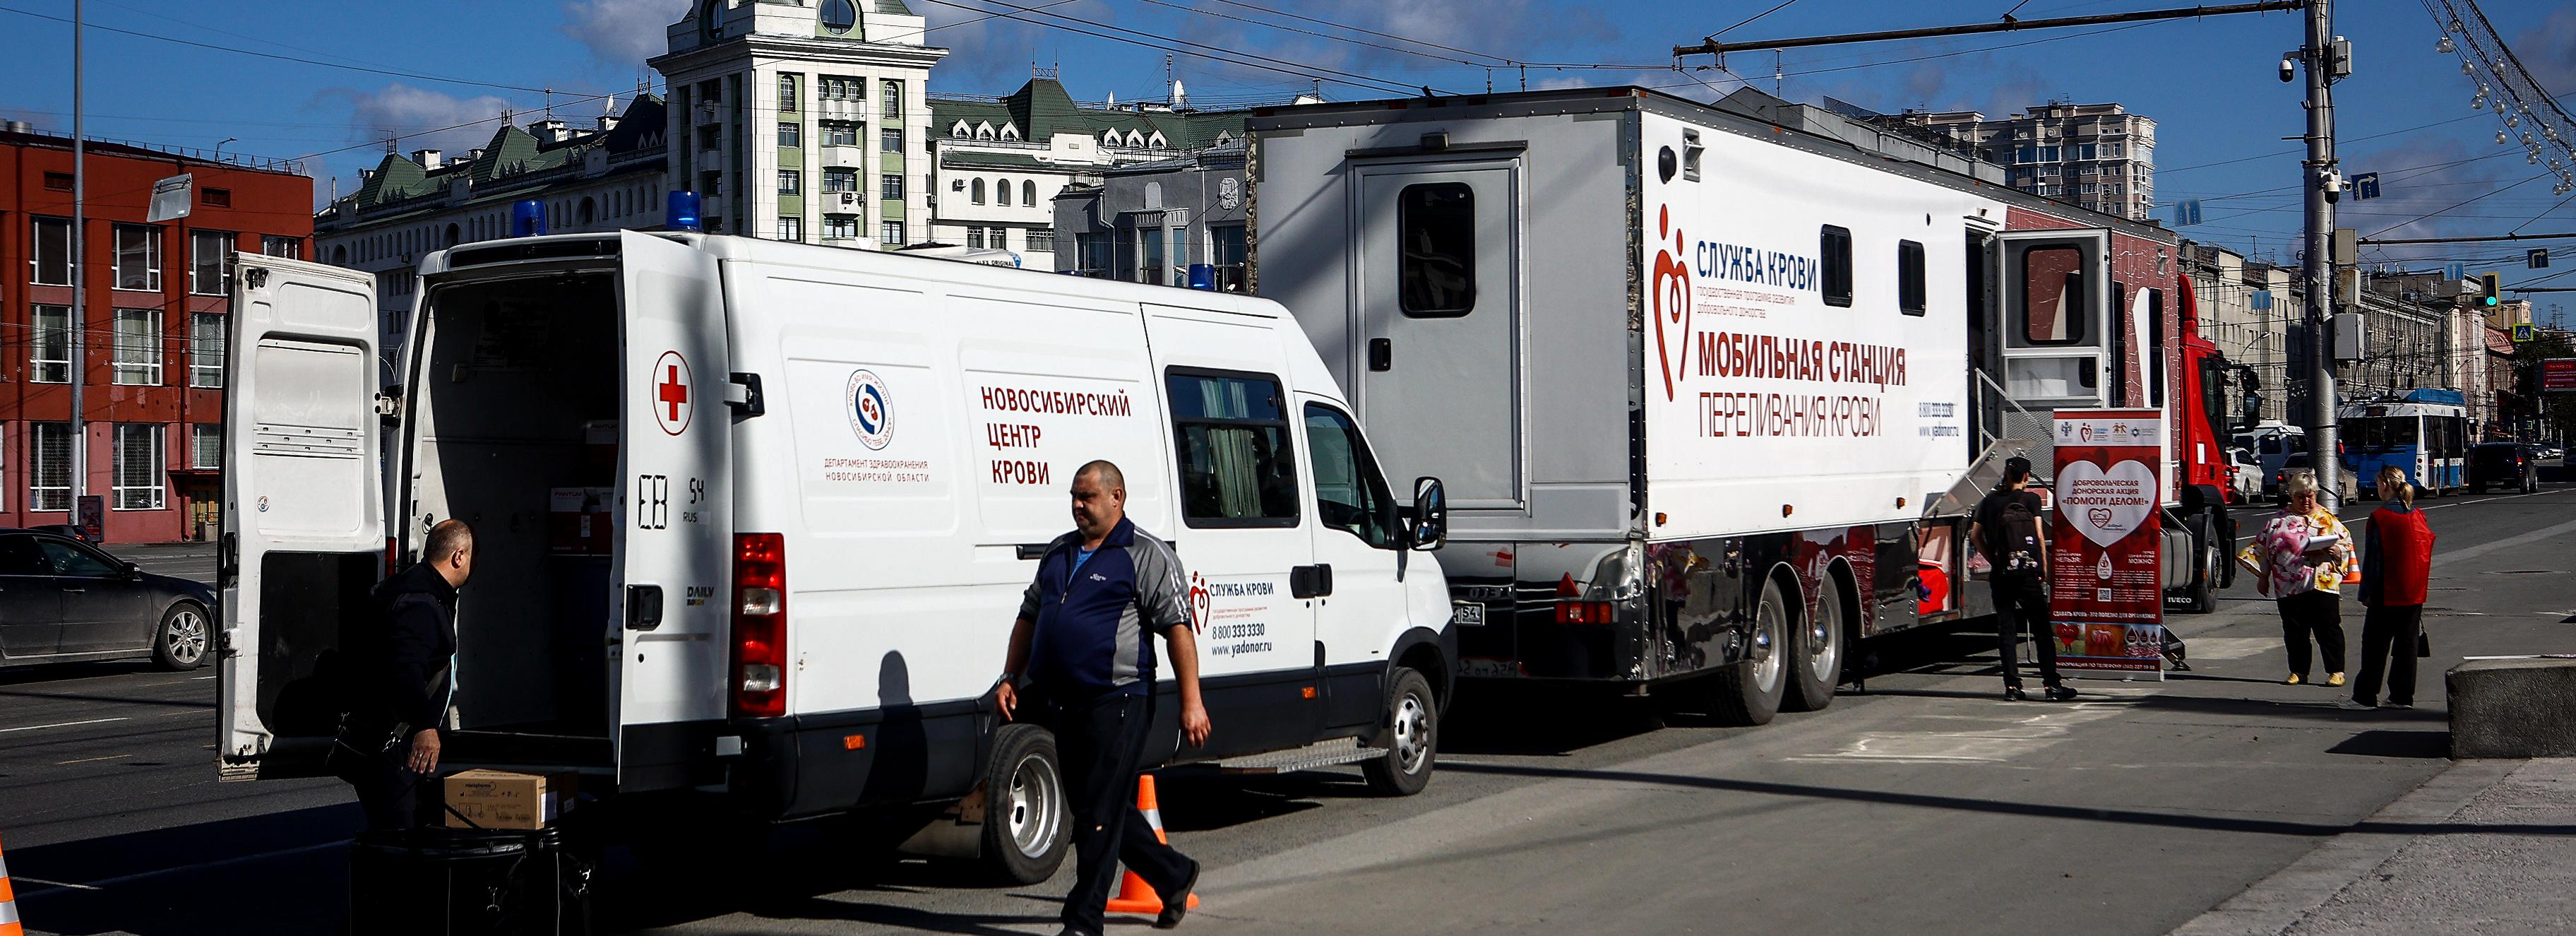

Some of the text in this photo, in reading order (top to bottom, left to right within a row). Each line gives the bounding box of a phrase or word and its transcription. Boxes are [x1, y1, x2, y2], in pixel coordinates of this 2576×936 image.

[1698, 241, 1817, 292] СЛУЖБА КРОВИ
[1698, 331, 1906, 393] МОБИЛЬНАЯ СТАНЦИЯ
[981, 386, 1131, 417] НОВОСИБИРСКИЙ
[1699, 392, 1881, 437] ПЕРЕЛИВАНИЯ КРОВИ
[986, 422, 1042, 451] ЦЕНТР
[825, 458, 928, 470] ДЕПАРТАМЕНТ ЗДРАВООХРАНЕНИЯ
[991, 460, 1050, 485] КРОВИ
[825, 471, 929, 482] НОВОСИБИРСКОЙ ОБЛАСТИ
[689, 478, 705, 504] 54
[2062, 497, 2149, 506] «ПОМОГИ ДЕЛОМ!»
[683, 512, 697, 523] RUS
[687, 586, 715, 598] DAILY
[1210, 582, 1274, 597] СЛУЖБА КРОВИ
[1462, 607, 1476, 618] 54
[1212, 623, 1265, 639] 8 800 333 3330
[1212, 640, 1272, 658] www. yadonor.ru
